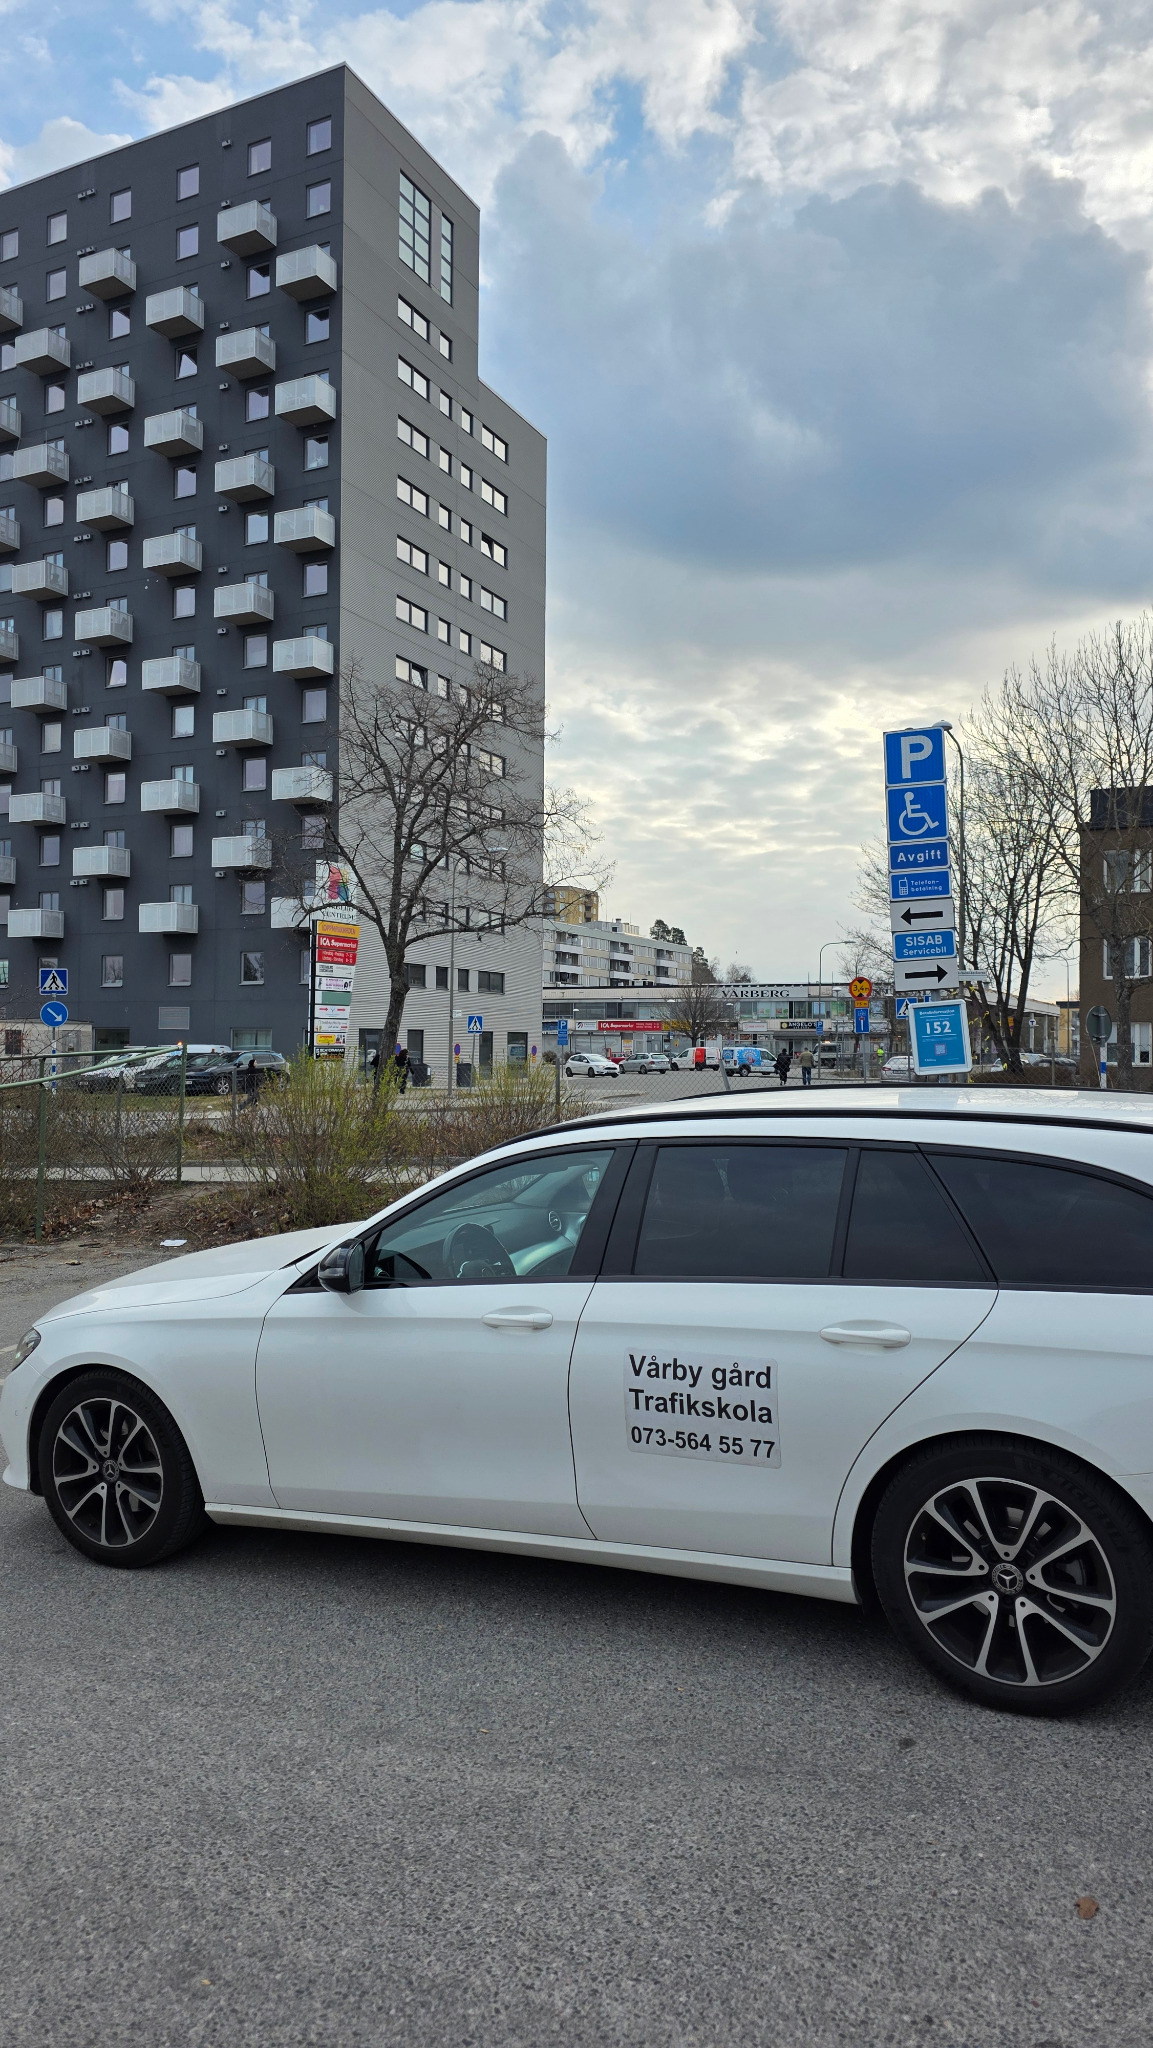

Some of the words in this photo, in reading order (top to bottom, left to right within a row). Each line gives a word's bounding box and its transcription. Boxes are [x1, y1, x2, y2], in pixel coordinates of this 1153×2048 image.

[901, 735, 933, 779] P
[897, 850, 941, 863] Avgift
[320, 937, 330, 946] ICA
[331, 939, 357, 948] Supermarket
[905, 935, 943, 947] SISAB
[903, 947, 947, 956] Servicebil
[560, 1020, 567, 1029] P
[926, 1021, 952, 1035] 152
[628, 1353, 703, 1388] Vårby
[711, 1361, 772, 1391] gård
[628, 1388, 773, 1424] Trafikskola
[630, 1425, 712, 1452] 073-564
[718, 1435, 744, 1455] 55
[749, 1438, 776, 1459] 77
